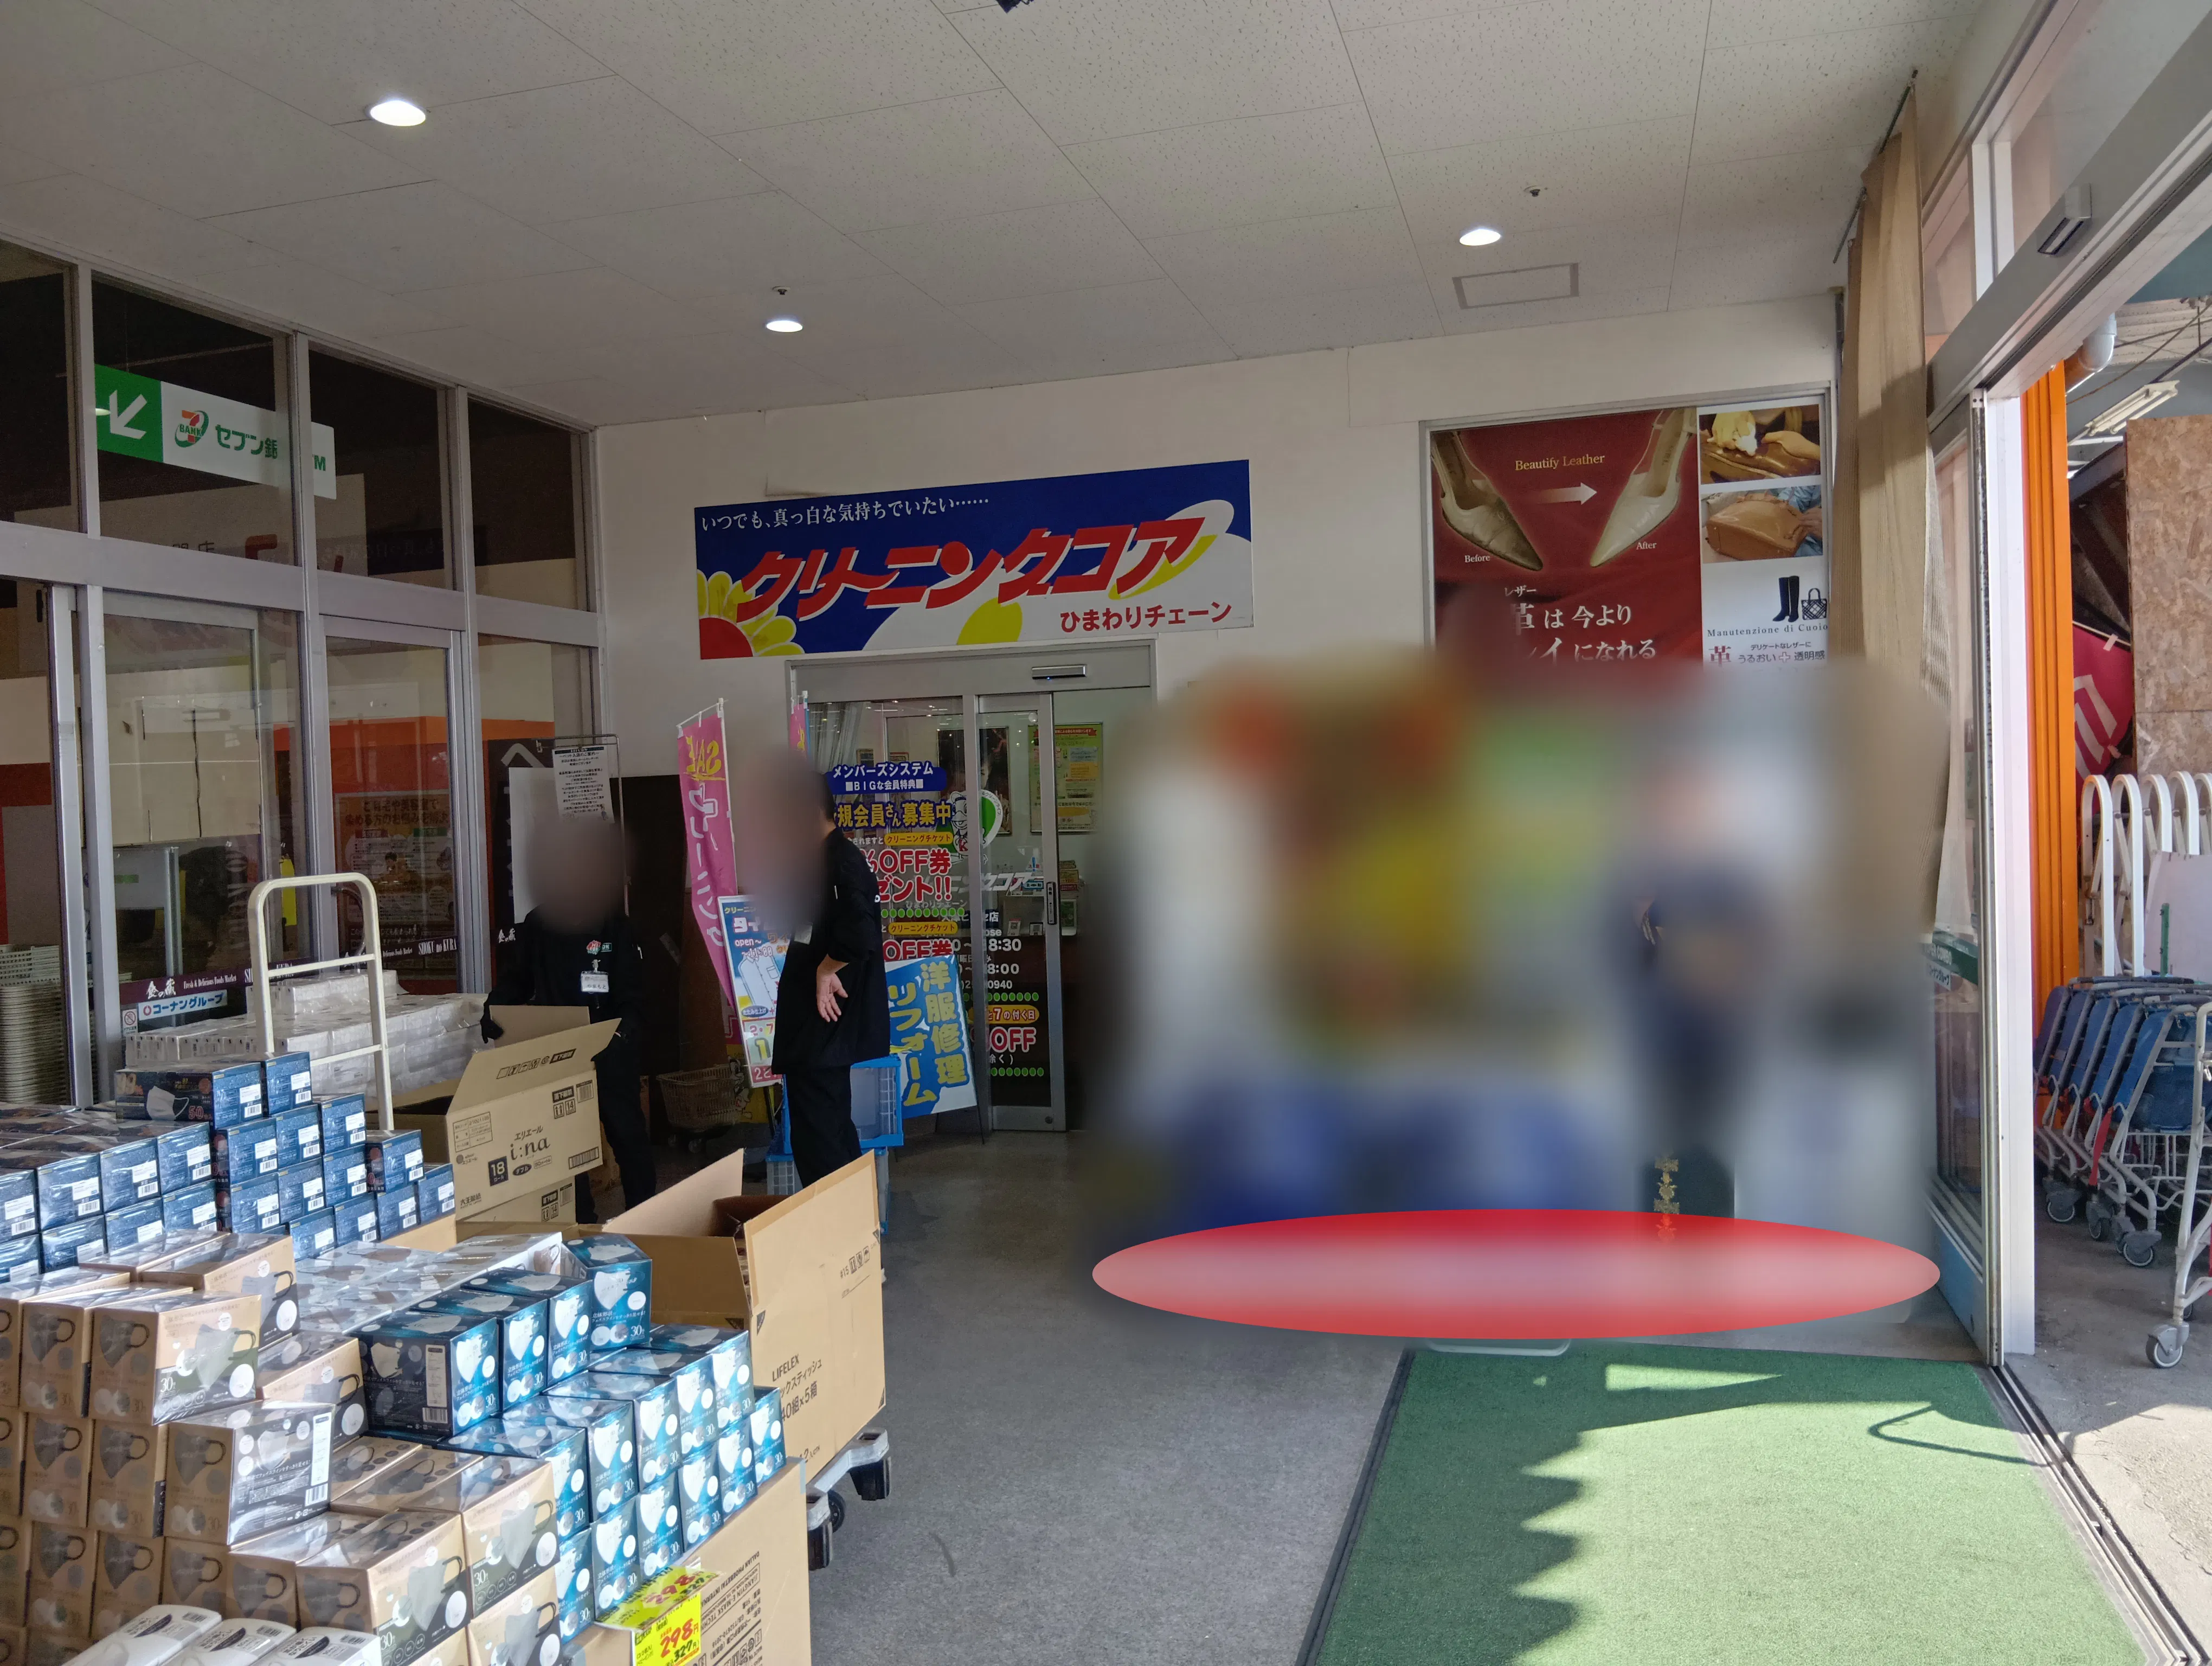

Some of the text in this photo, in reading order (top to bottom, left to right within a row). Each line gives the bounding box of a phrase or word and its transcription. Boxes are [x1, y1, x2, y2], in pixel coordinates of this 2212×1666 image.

[179, 424, 202, 437] BANK
[1515, 453, 1605, 471] Beautify Leather
[1636, 540, 1657, 550] After
[1464, 553, 1490, 564] Before
[1504, 585, 1537, 597] レザー
[1059, 601, 1233, 633] ひまわりチェーン
[1707, 626, 1779, 637] Manutenzione
[1526, 637, 1656, 666] イになれる
[1751, 642, 1812, 651] デリケートなレザーに
[1708, 645, 1732, 667] 革
[1738, 650, 1826, 664] うるおい 透明感
[833, 761, 934, 778] メンバーズシステム
[835, 800, 951, 828] 規会員さん募集中
[886, 832, 951, 844] クリーニングチケット
[877, 874, 951, 902] ゼント!!
[891, 924, 955, 933] クリーニングチケット
[988, 939, 1021, 951] 8:30
[988, 964, 1019, 975] 8:00
[225, 975, 236, 983] Market
[988, 981, 1012, 989] 0940
[153, 992, 224, 1014] コーナングループ
[921, 960, 968, 1084] 洋服修理
[987, 1007, 1036, 1021] と7の付く日
[888, 982, 937, 1106] リフォーム
[991, 1028, 1037, 1051] OFF
[515, 1125, 543, 1141] エリエール
[491, 1162, 505, 1176] 18
[772, 1354, 800, 1382] LIFELEX
[780, 1358, 823, 1398] ックスティッシュ
[744, 1551, 760, 1568] DALIAN
[718, 1594, 736, 1616] E-MASK
